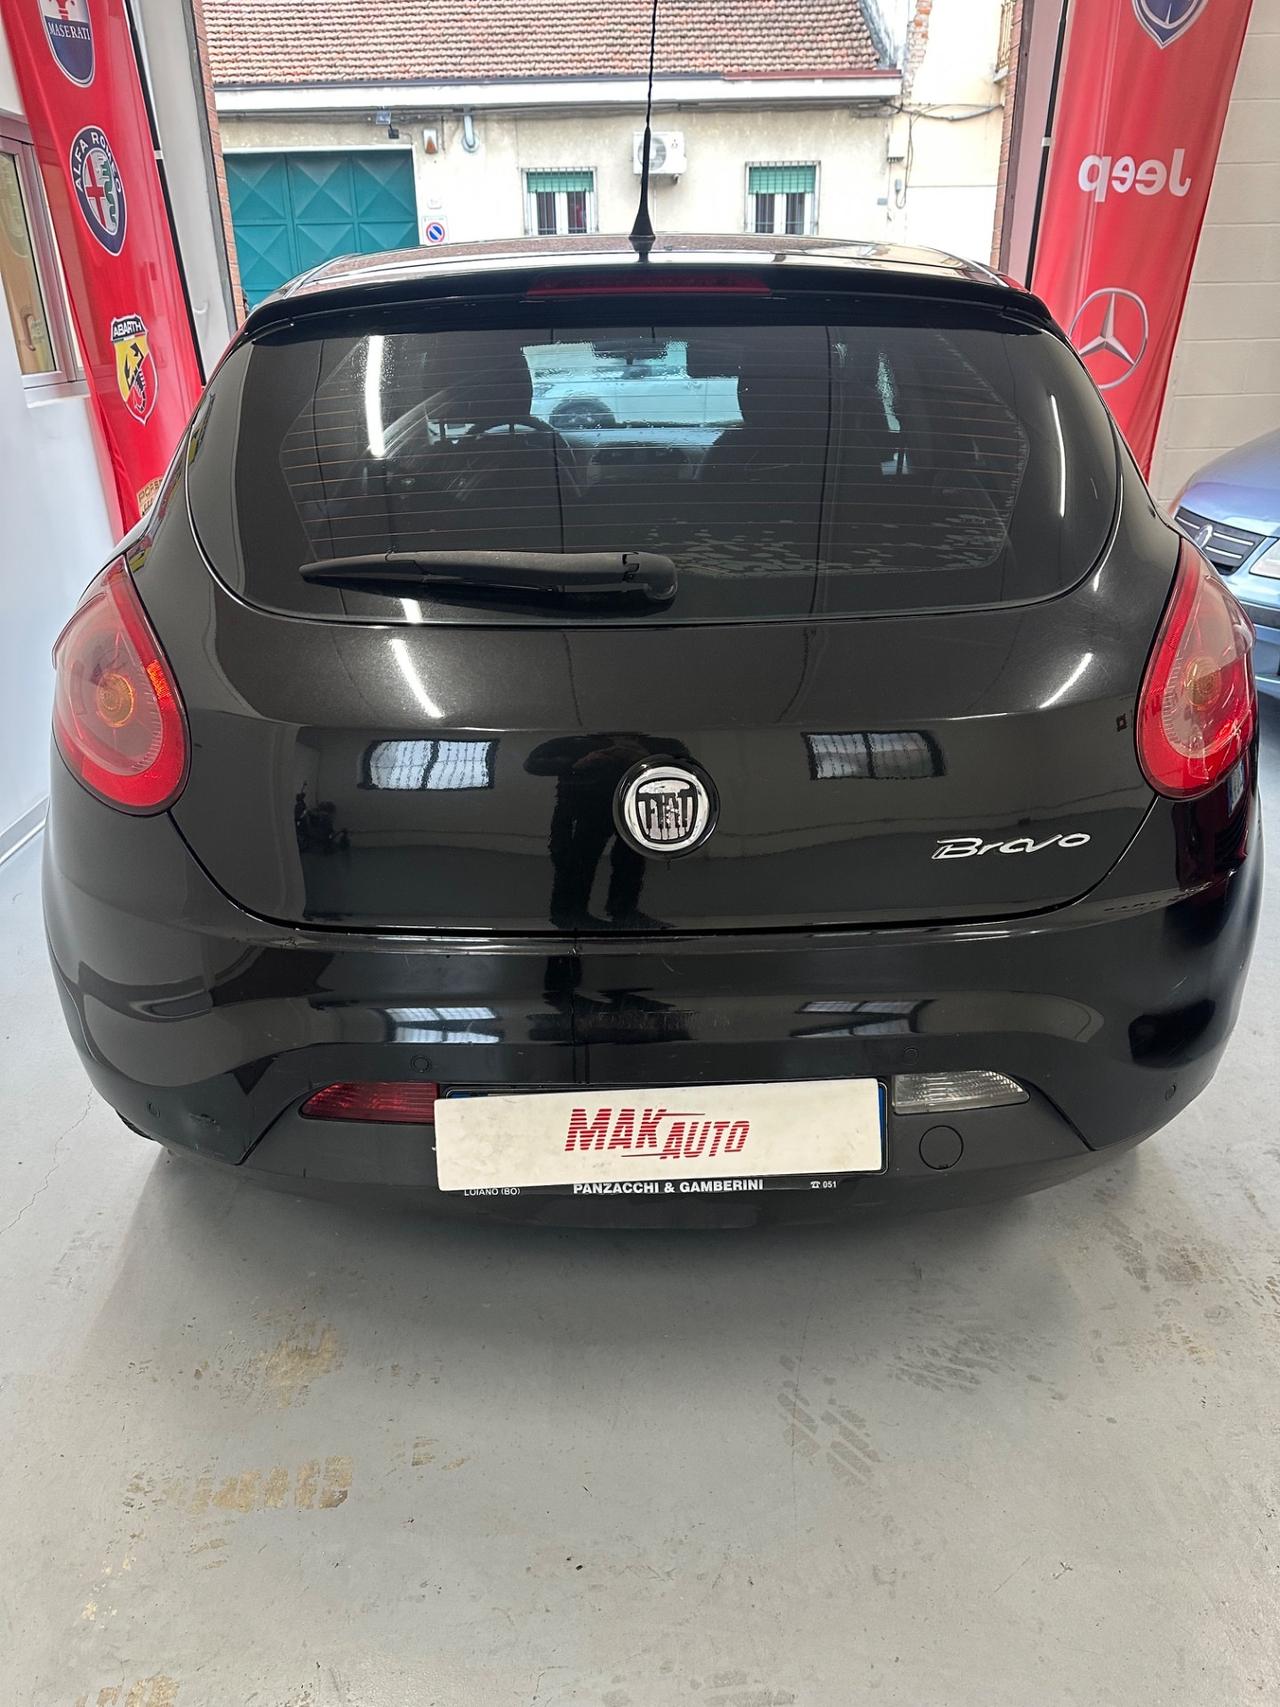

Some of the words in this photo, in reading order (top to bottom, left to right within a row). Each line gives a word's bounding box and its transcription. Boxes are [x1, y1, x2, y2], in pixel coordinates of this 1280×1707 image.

[48, 22, 91, 40] MASERATI
[73, 138, 89, 193] ALFA
[113, 320, 142, 338] ABARTH
[637, 788, 697, 829] FIAT
[931, 832, 1091, 860] Bravo
[564, 1108, 668, 1152] MAK
[659, 1120, 750, 1160] AUTO
[464, 1187, 499, 1197] LOIANO
[573, 1181, 659, 1195] PANZACCHI
[663, 1180, 675, 1194] &
[679, 1178, 764, 1194] GAMBERINI
[822, 1180, 838, 1189] 051
